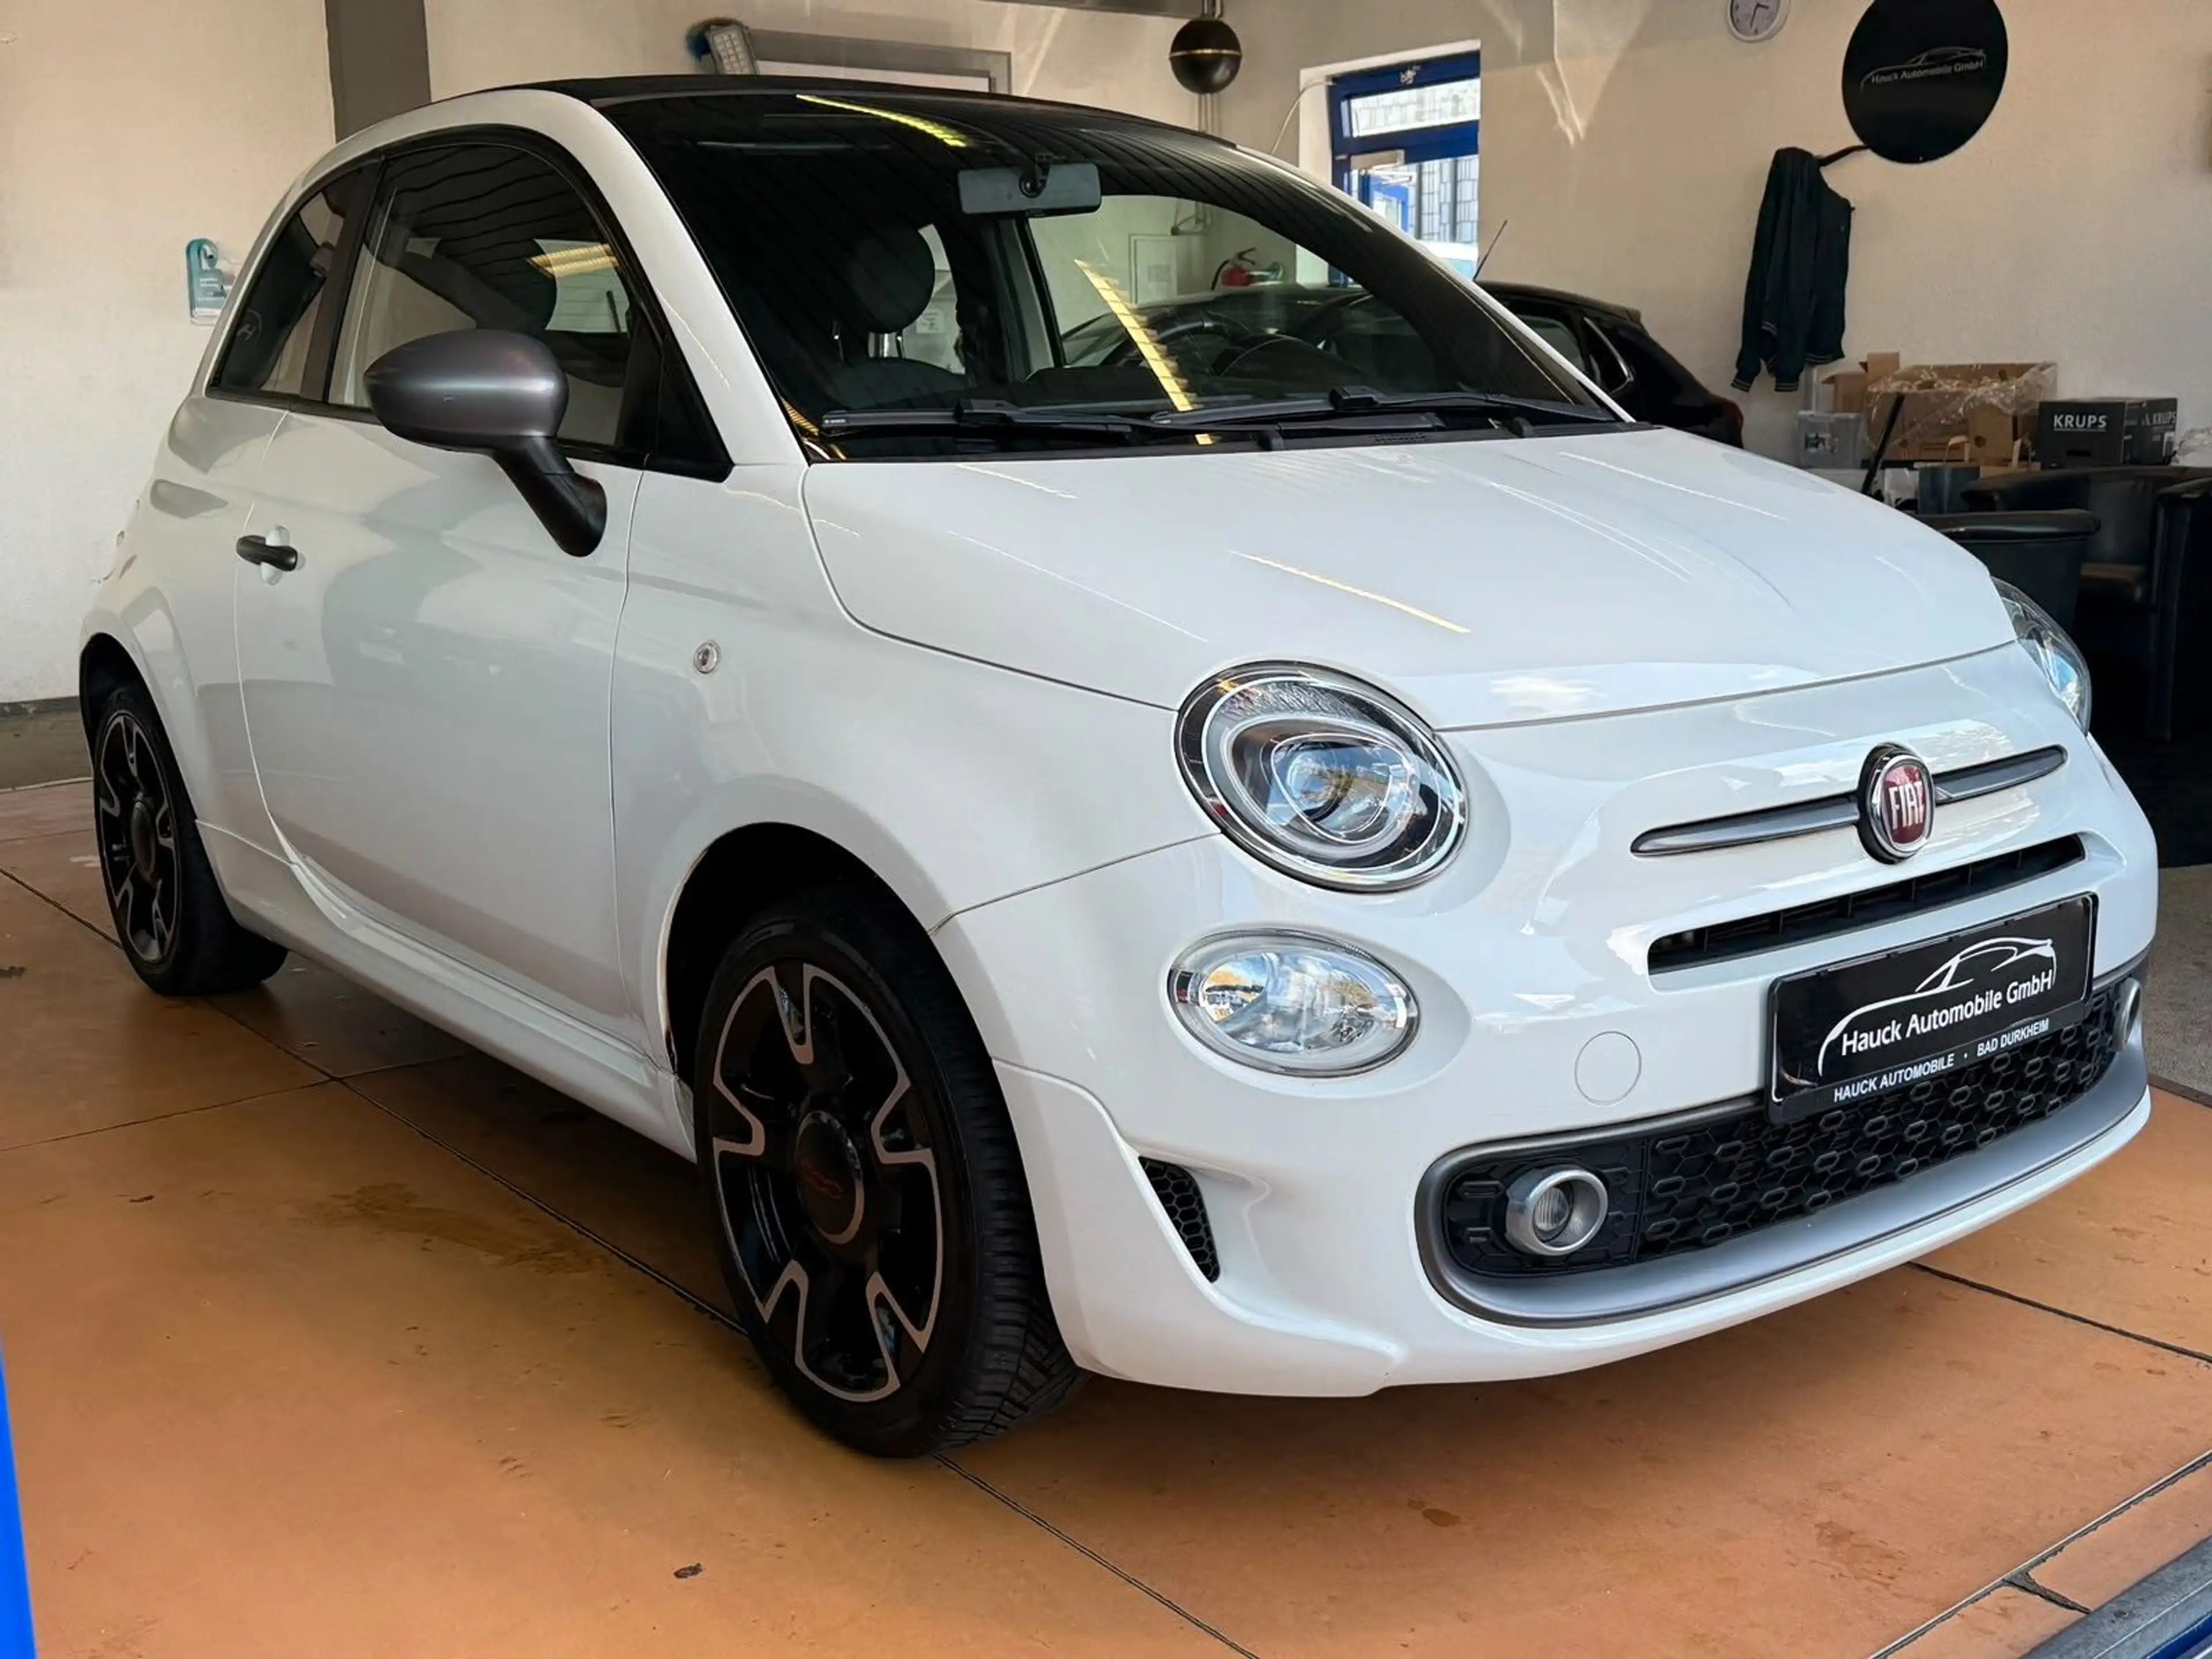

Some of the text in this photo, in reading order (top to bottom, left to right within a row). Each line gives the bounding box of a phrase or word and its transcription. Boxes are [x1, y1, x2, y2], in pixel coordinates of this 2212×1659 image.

[2053, 414, 2107, 428] KRUPS
[1888, 780, 1924, 830] FIAT
[1842, 969, 2052, 1056] Hauck Automobile GmbH
[1834, 1078, 1877, 1103] HAUCK
[1880, 1053, 1955, 1089] AUTOMOBILE
[1976, 1037, 1999, 1058] BAD
